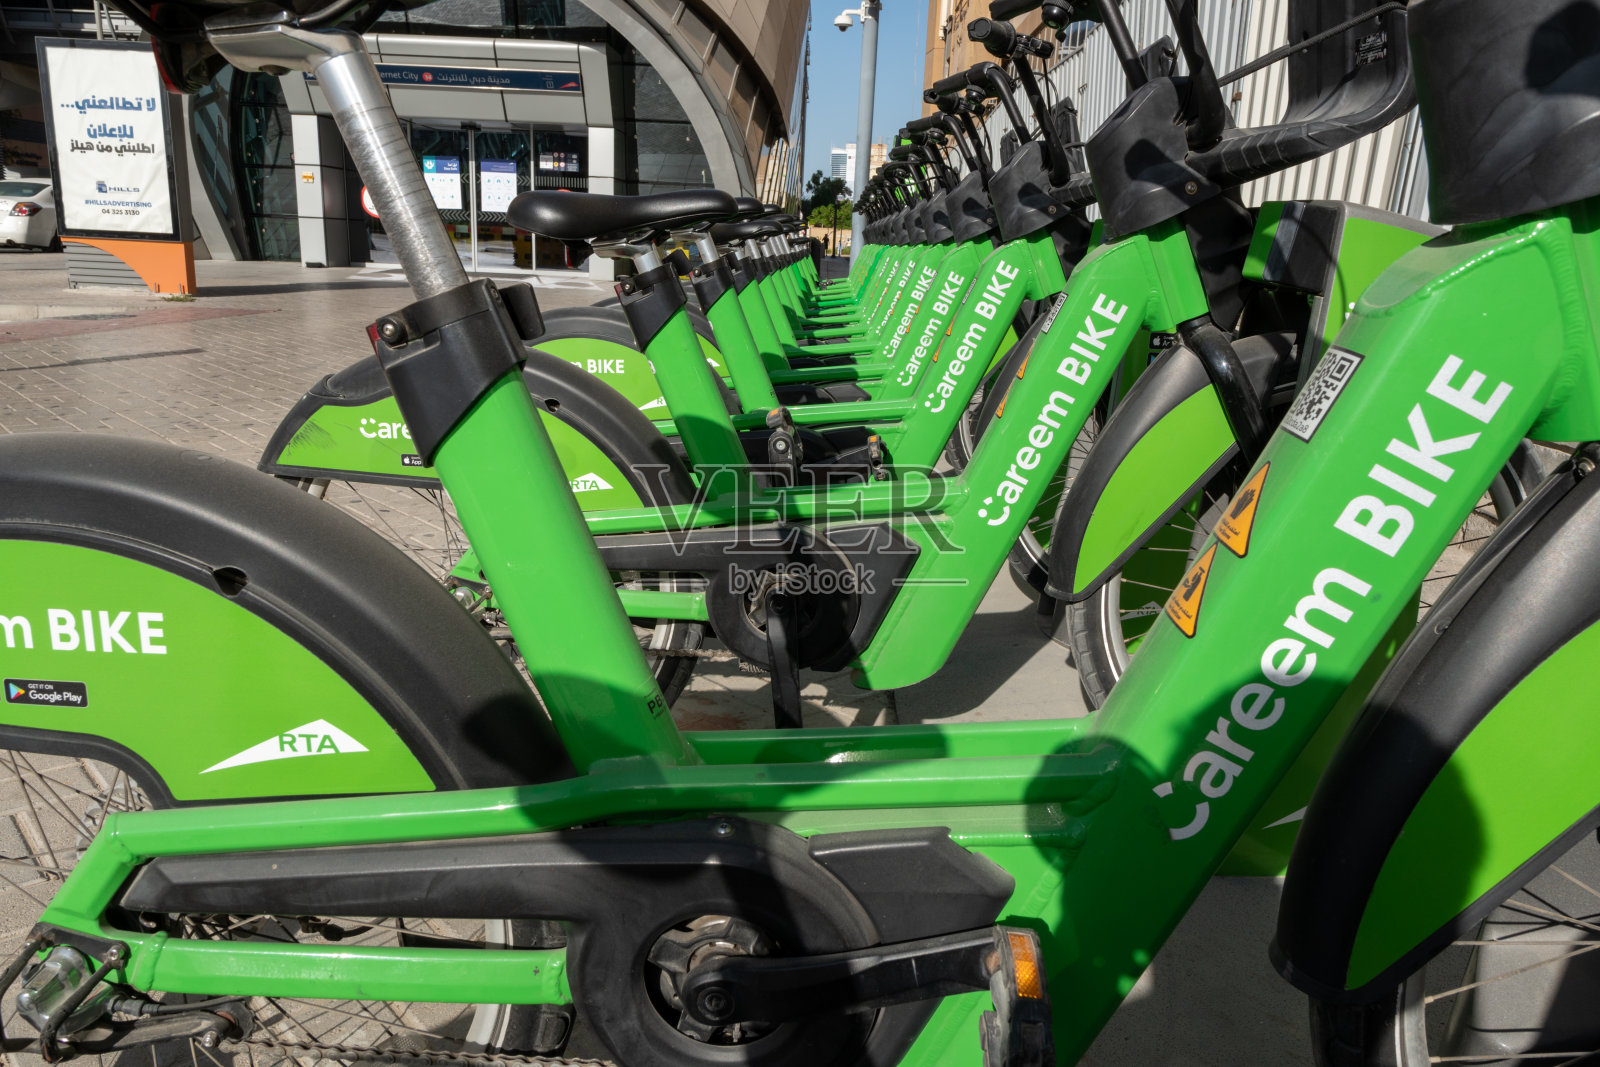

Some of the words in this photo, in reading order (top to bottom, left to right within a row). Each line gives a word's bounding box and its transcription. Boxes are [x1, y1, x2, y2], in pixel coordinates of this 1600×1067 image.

[402, 71, 419, 82] City
[469, 75, 486, 85] دبي
[146, 97, 156, 112] لا
[86, 123, 134, 142] للإعلان
[70, 139, 94, 154] هيلز
[96, 141, 113, 153] من
[115, 142, 155, 157] اطلبني
[84, 199, 152, 208] #HILLSADVERTISING
[883, 303, 918, 358] Careem
[911, 266, 937, 301] BIKE
[897, 318, 942, 386] Careem
[932, 271, 965, 316] BIKE
[925, 323, 986, 414] Careem
[974, 260, 1020, 321] BIKE
[584, 359, 625, 374] BIKE
[978, 391, 1076, 527] Careem
[1057, 292, 1129, 386] BIKE
[570, 479, 600, 491] RTA
[1153, 567, 1373, 842] Careem
[1333, 354, 1514, 558] BIKE
[47, 608, 168, 655] BIKE
[28, 690, 62, 703] Google
[63, 692, 82, 704] Play
[278, 733, 341, 753] RTA
